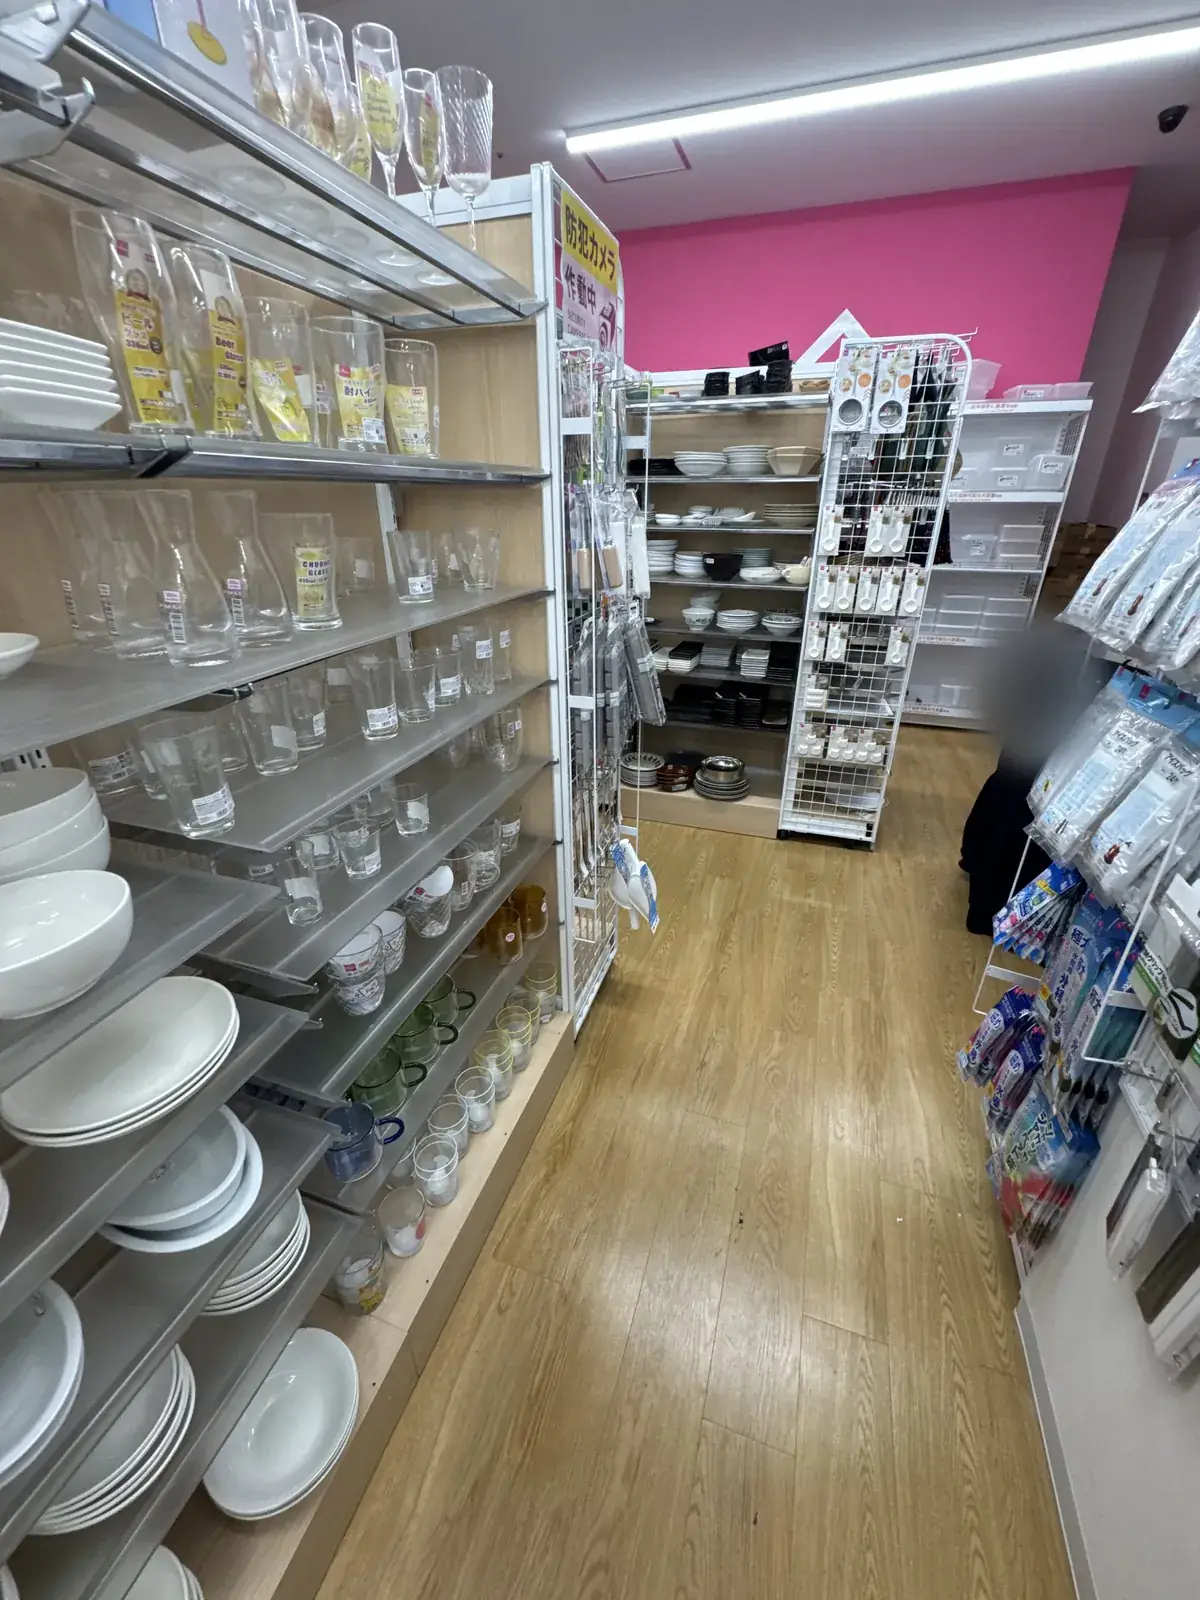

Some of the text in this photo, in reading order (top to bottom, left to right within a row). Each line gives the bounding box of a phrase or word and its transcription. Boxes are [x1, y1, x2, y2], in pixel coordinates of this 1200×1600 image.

[565, 204, 616, 281] 防犯カメラ
[564, 263, 597, 315] 作動中
[215, 336, 236, 350] Beer
